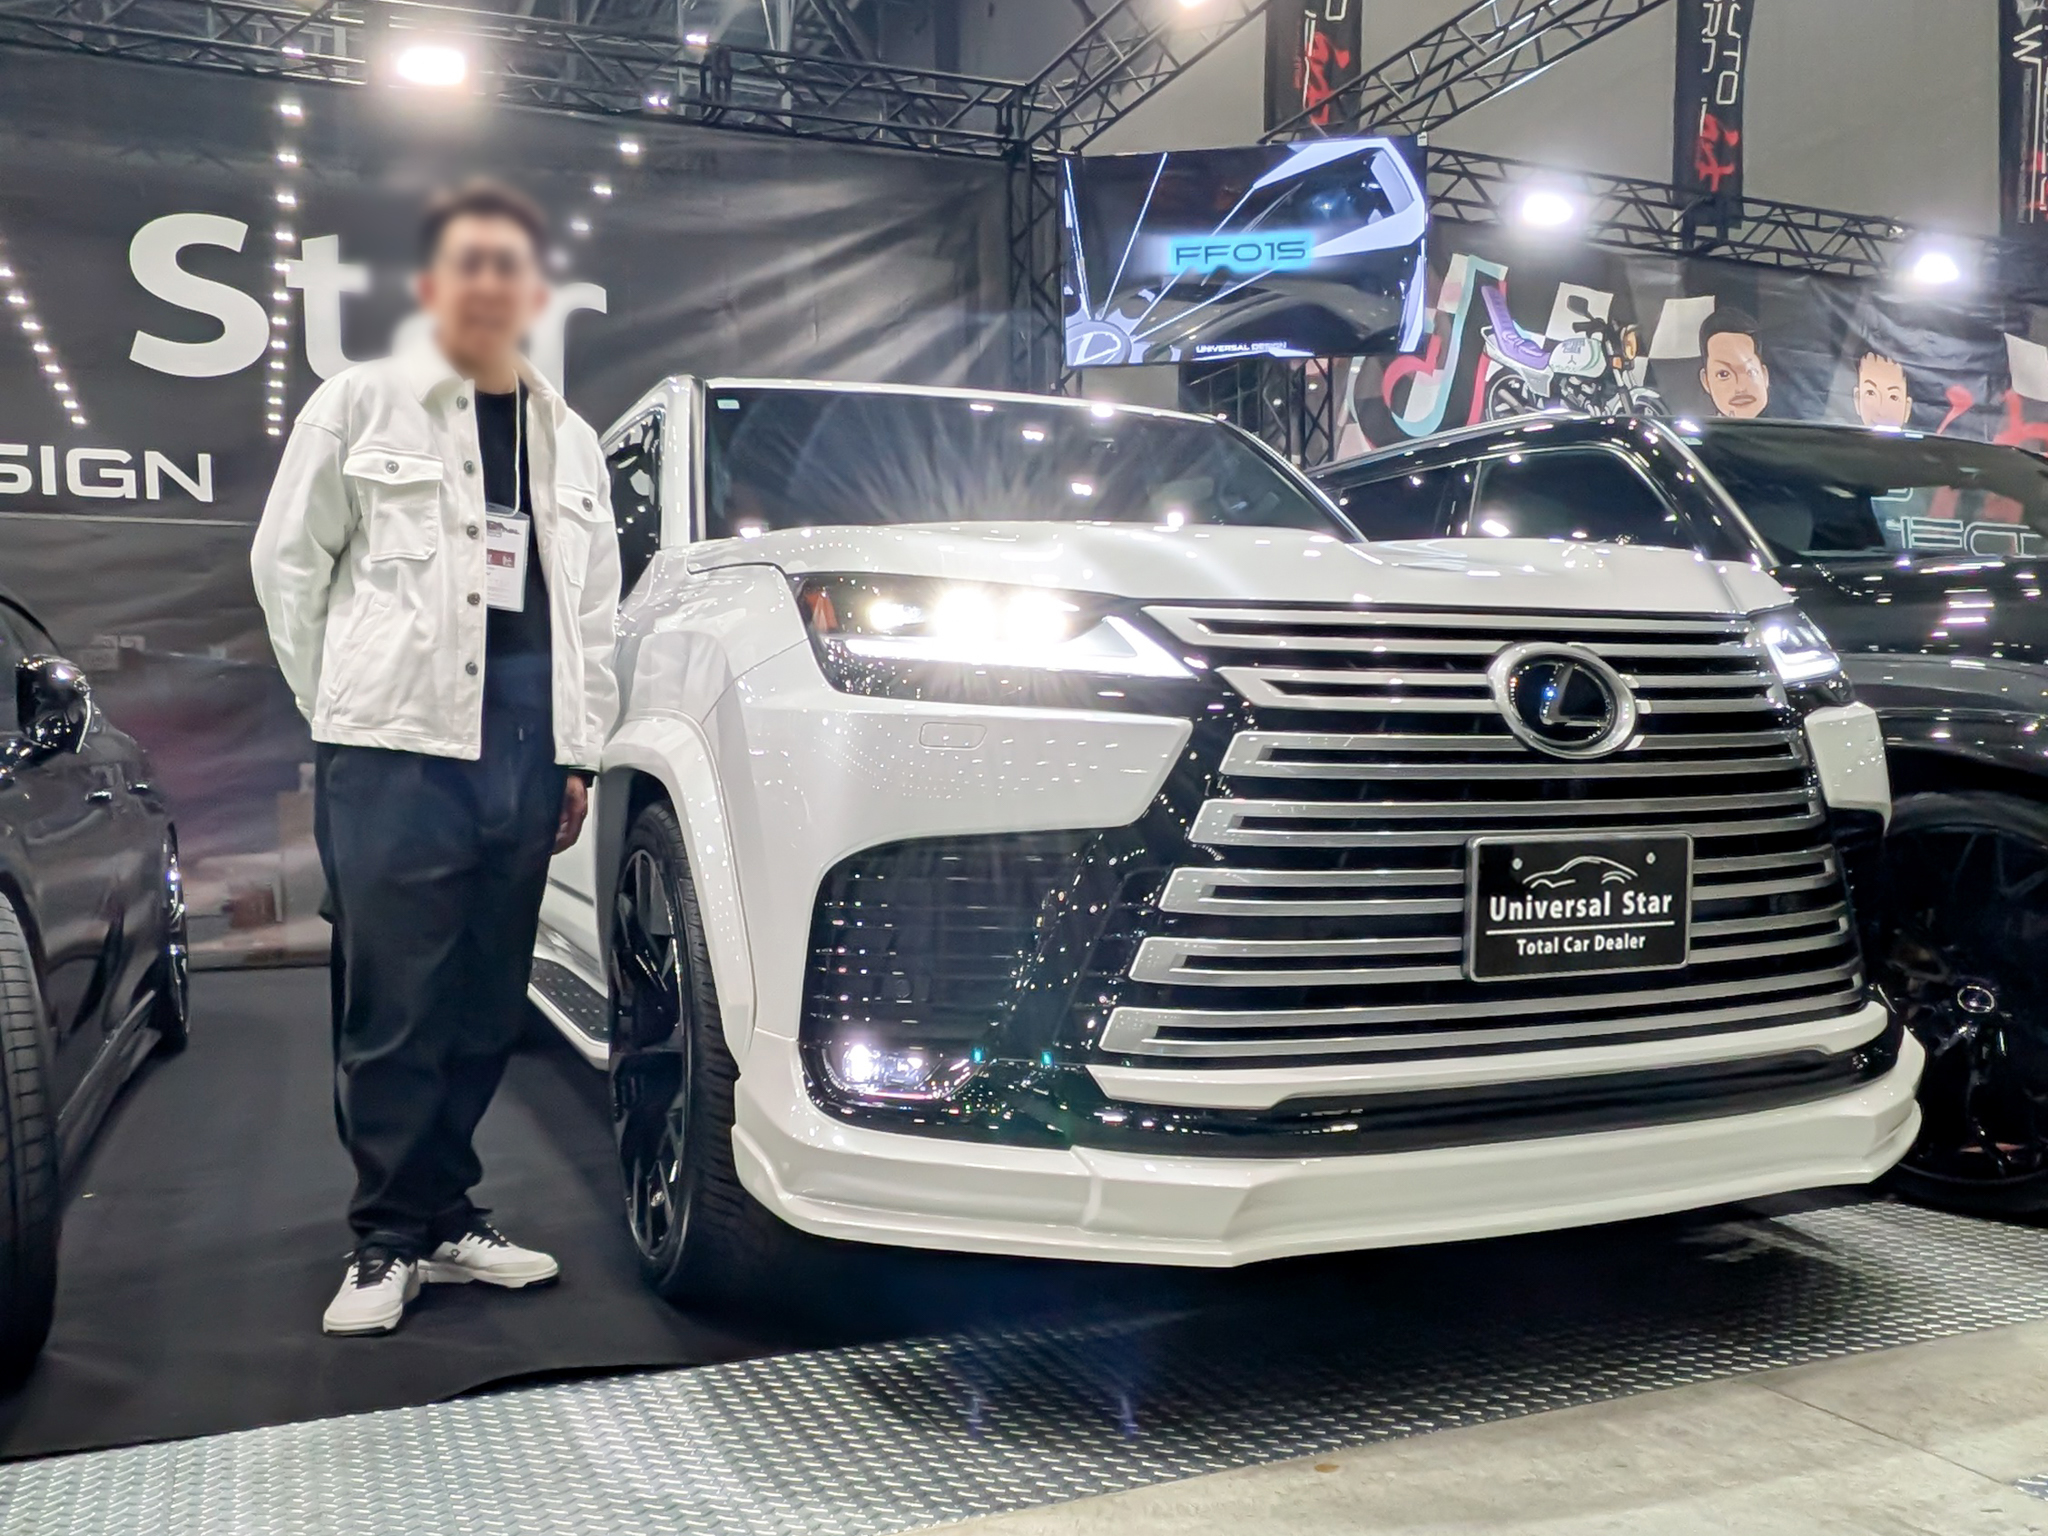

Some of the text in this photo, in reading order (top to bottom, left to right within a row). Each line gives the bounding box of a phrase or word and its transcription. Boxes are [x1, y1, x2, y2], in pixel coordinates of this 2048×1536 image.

[129, 213, 607, 398] Str
[1195, 343, 1250, 354] UNIVERSAL
[1489, 890, 1673, 922] Universal Star
[1516, 932, 1646, 956] Total Car Dealer
